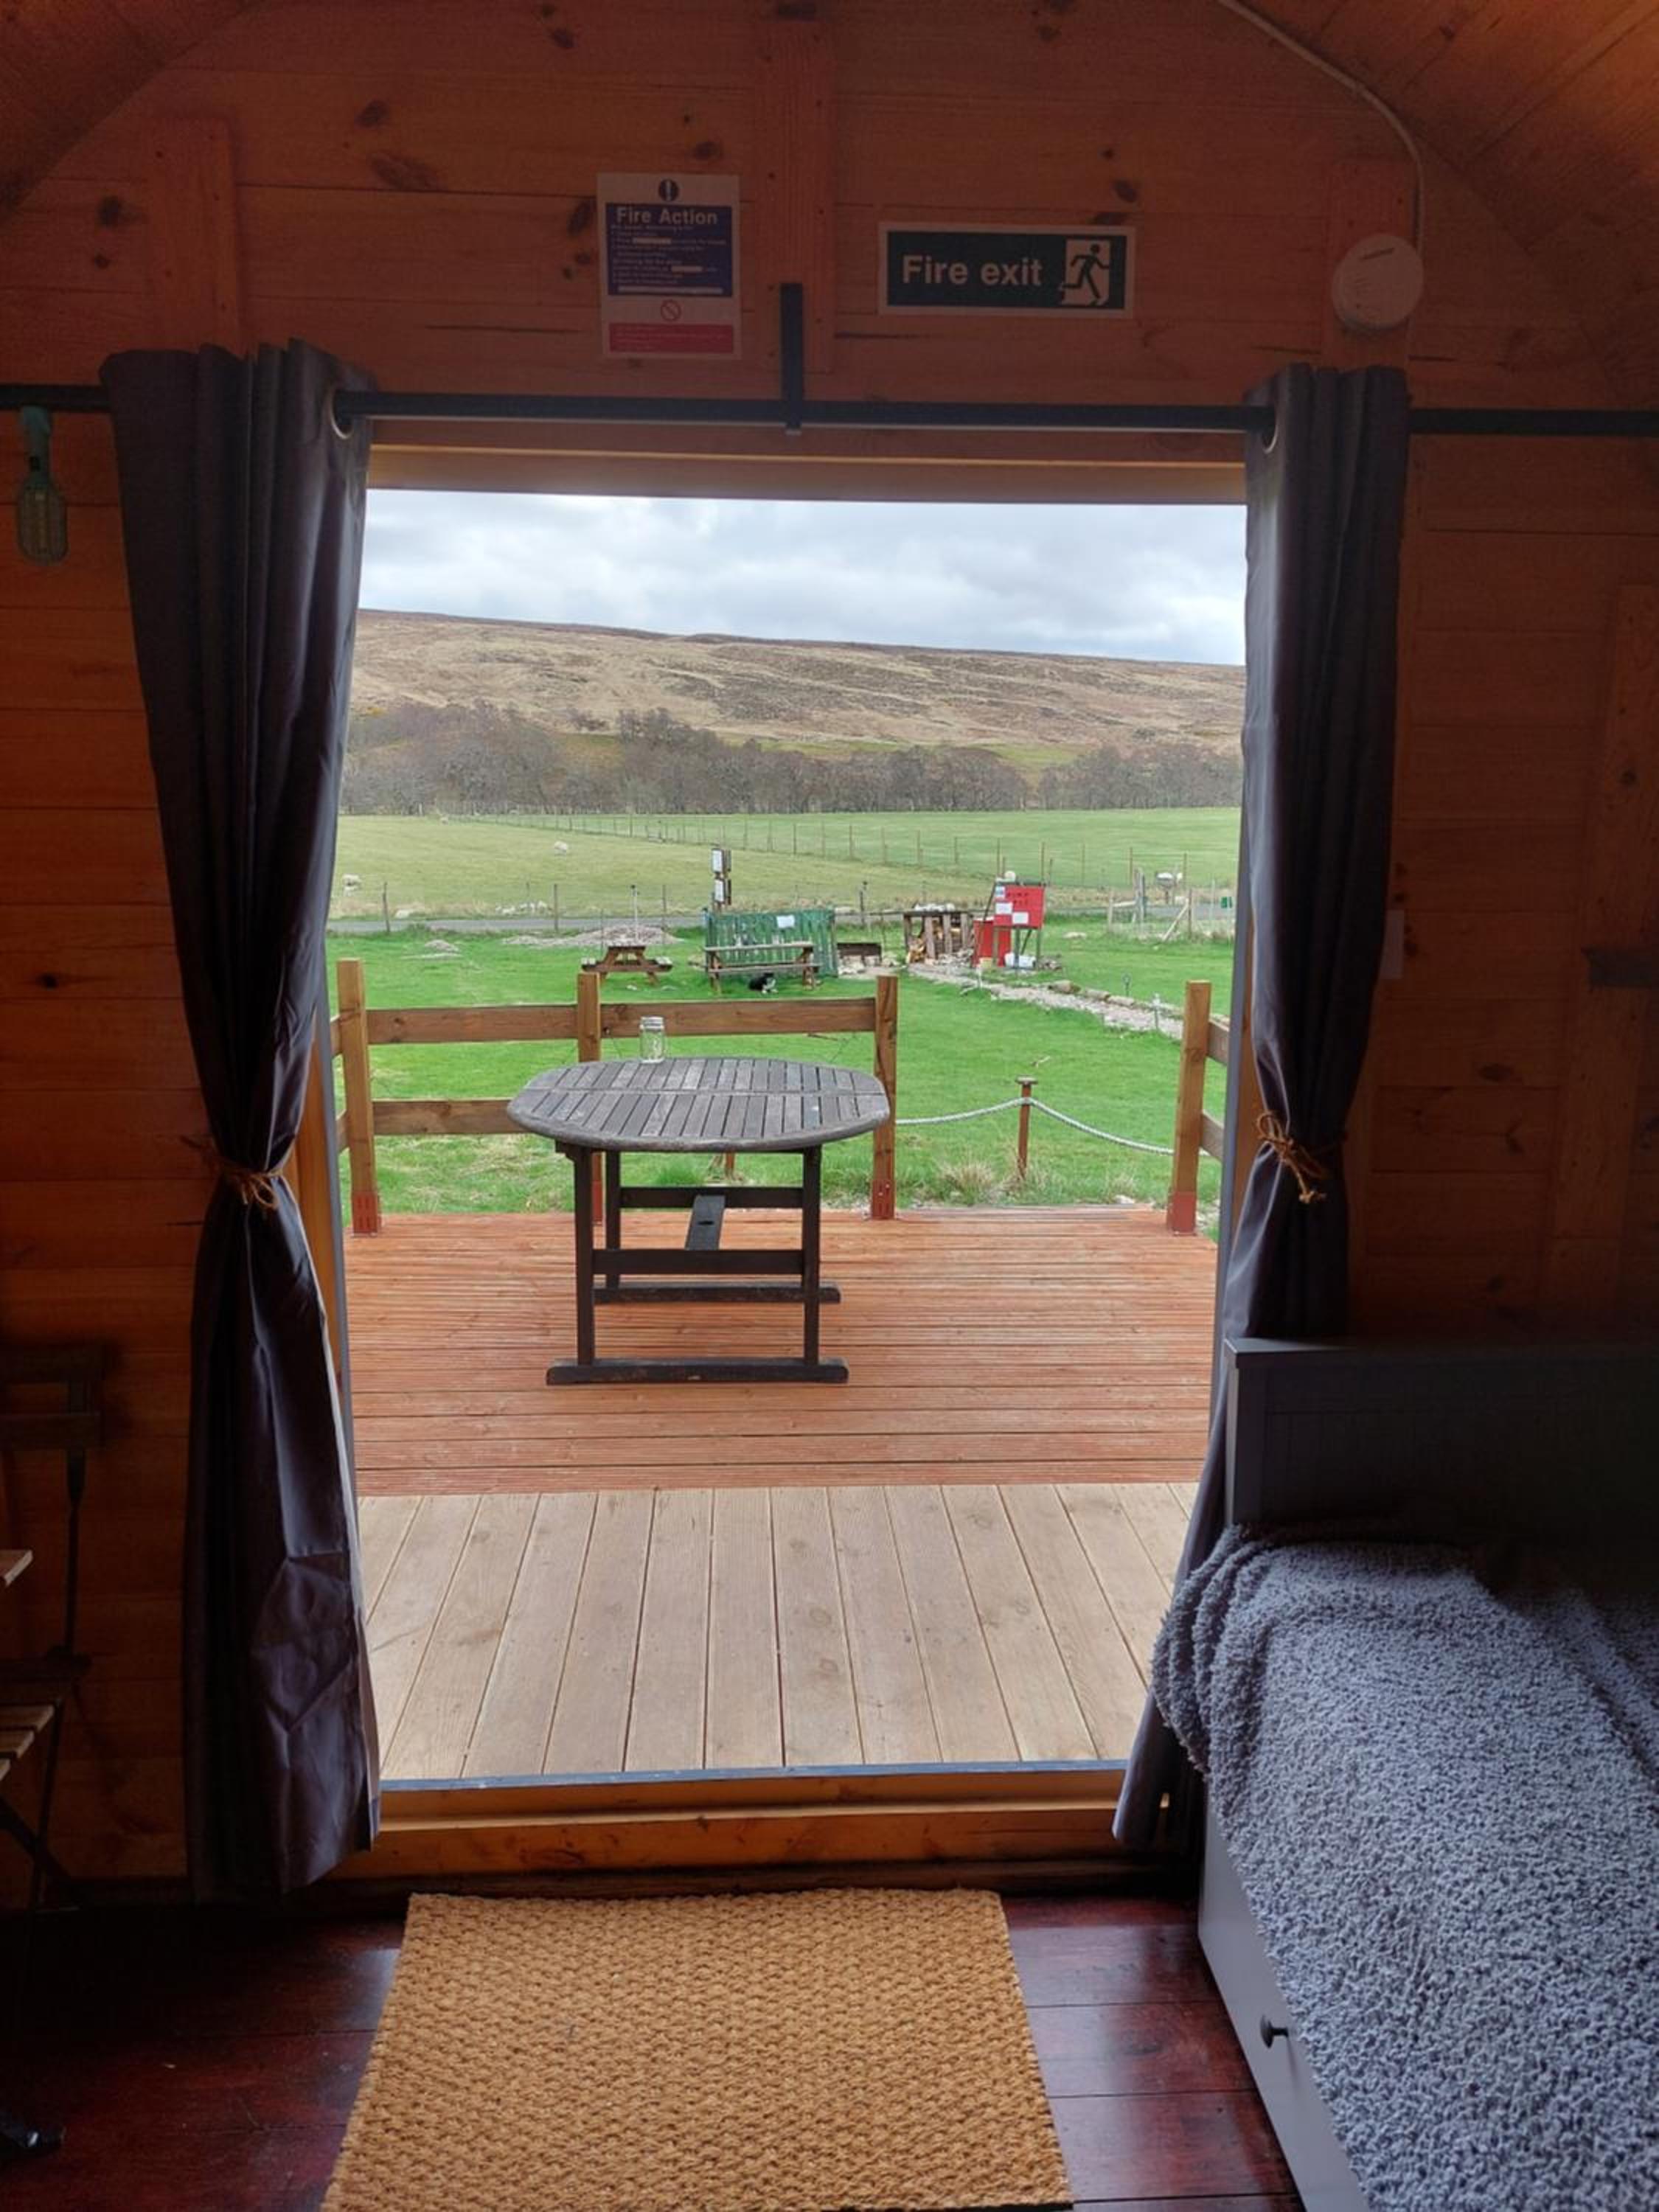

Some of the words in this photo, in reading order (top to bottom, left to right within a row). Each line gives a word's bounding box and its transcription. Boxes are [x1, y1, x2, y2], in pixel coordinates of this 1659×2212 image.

[616, 207, 651, 223] Fire
[659, 208, 718, 225] Action
[902, 254, 968, 285] Fire
[980, 257, 1043, 286] exit
